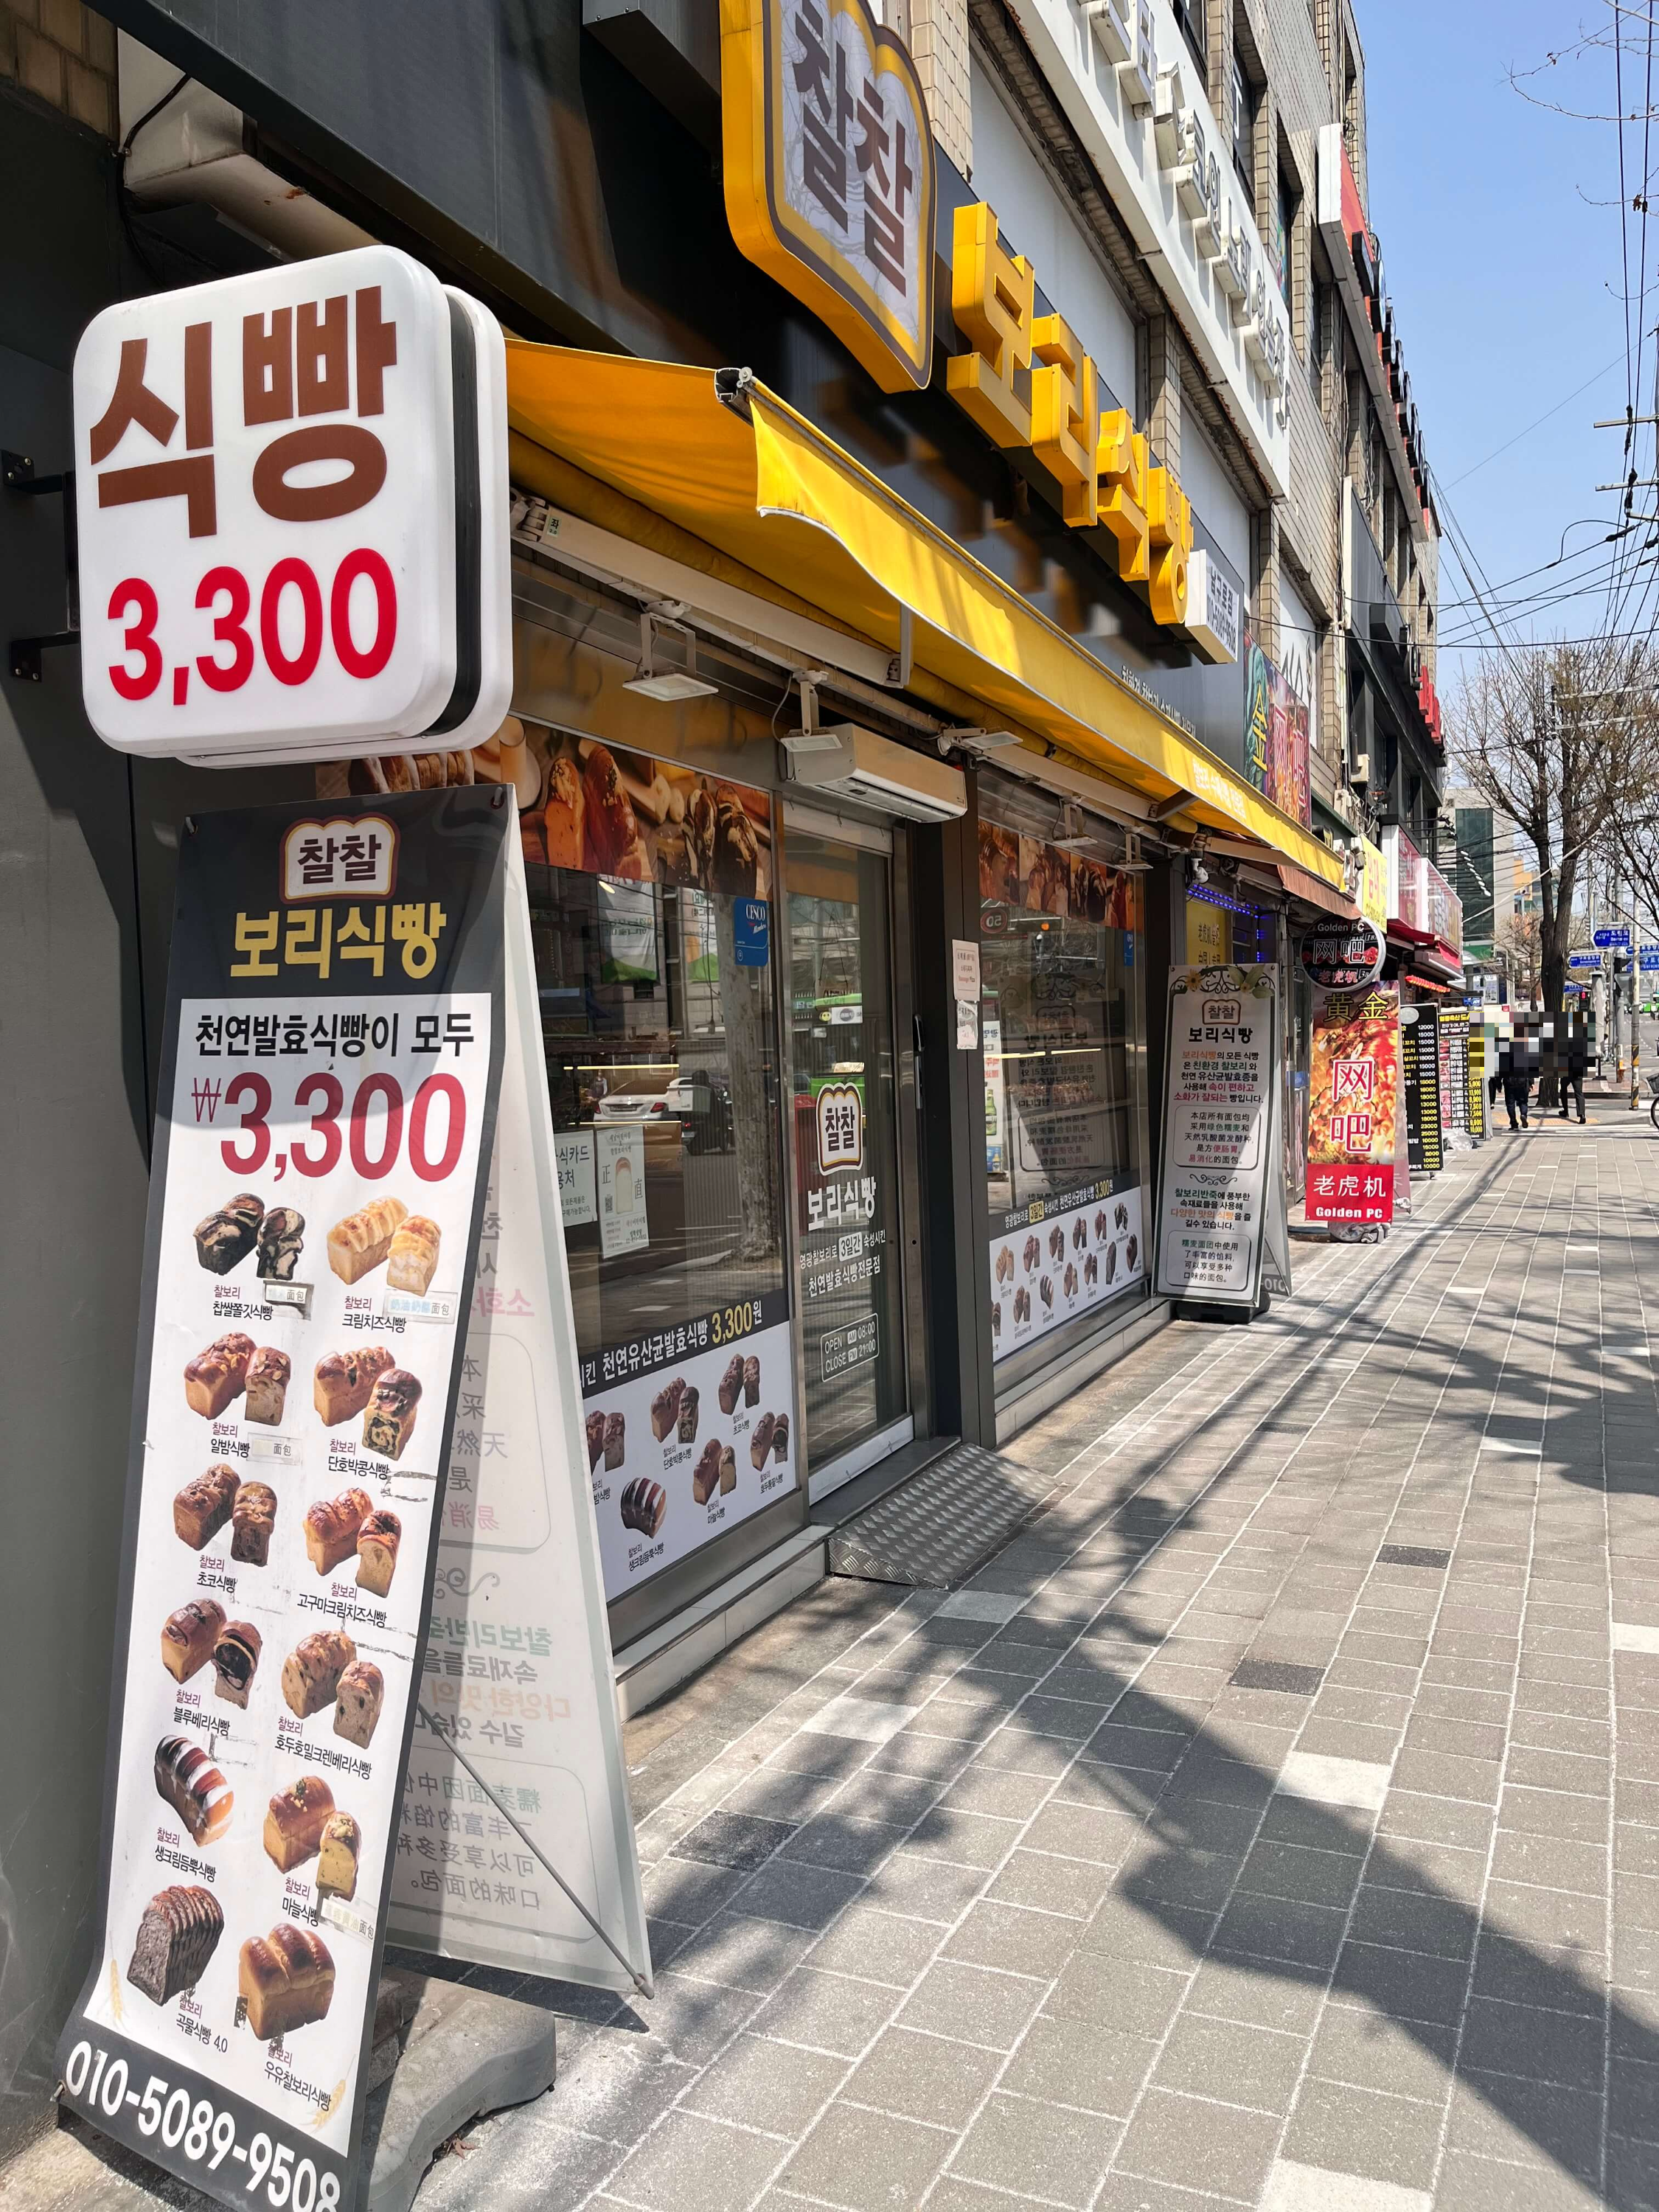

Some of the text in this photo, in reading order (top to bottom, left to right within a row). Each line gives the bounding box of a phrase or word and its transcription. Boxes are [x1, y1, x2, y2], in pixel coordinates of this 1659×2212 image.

[793, 0, 913, 298] 찰찰
[90, 285, 397, 538] 식빵
[947, 201, 1194, 625] 보리식빵
[108, 548, 397, 706] 3,300
[296, 834, 381, 884] 찰찰
[745, 904, 765, 921] CESCO
[1318, 923, 1364, 931] Golden PC
[230, 902, 447, 979] 보리식빵
[1312, 939, 1366, 964] 网吧
[1208, 1005, 1235, 1020] 찰찰
[195, 1013, 475, 1057] 천연발효식빵이 모두
[1188, 1027, 1253, 1043] 보리식빵
[1183, 1061, 1191, 1069] 은
[1193, 1061, 1219, 1071] 친환경
[1221, 1062, 1247, 1071] 찰보리
[1226, 1051, 1242, 1060] 모든
[1243, 1051, 1259, 1060] 식빵
[1180, 1072, 1196, 1081] 천연
[1183, 1082, 1255, 1093] 사용해 속이 편하고
[1173, 1093, 1264, 1104] 소화가 잘되는 빵입니다.
[1329, 1057, 1375, 1155] 网吧
[825, 1105, 855, 1150] 찰찰
[1191, 1112, 1250, 1122] 本店所有面包均
[556, 1145, 590, 1166] 식카드
[1227, 1192, 1251, 1201] 풍부한
[1313, 1175, 1386, 1198] 老虎机
[807, 1176, 877, 1231] 보리식빵
[1171, 1208, 1196, 1218] 다양한
[1198, 1209, 1215, 1219] 맛의
[1220, 1202, 1243, 1211] 사용해
[1315, 1207, 1383, 1219] Golden PC
[1185, 1219, 1235, 1231] 길수 있습니다.
[799, 1228, 886, 1270] 영광찰보리로 3일간 숙성시킨
[1184, 1261, 1233, 1272] 可以享受多种
[214, 1284, 240, 1300] 찰보리
[344, 1295, 372, 1311] 찰보리
[212, 1301, 274, 1321] 찹쌀쫄깃식빵
[341, 1313, 407, 1334] 크림치즈식빵
[824, 1335, 843, 1355] OPEN
[858, 1321, 876, 1338] 08:00
[602, 1318, 708, 1382] 천연유산균발효식빵
[825, 1351, 847, 1373] CLOSE
[858, 1338, 877, 1357] 21:00
[212, 1422, 238, 1437] 찰보리
[210, 1438, 251, 1458] 알밤식빵
[329, 1439, 356, 1455] 찰보리
[327, 1455, 391, 1481] 단호박콩식빵
[199, 1555, 224, 1572] 찰보리
[196, 1571, 237, 1594] 초코식빵
[331, 1582, 357, 1601] 찰보리
[296, 1593, 387, 1629] 고구마크림치즈식빵
[175, 1688, 201, 1708] 찰보리
[173, 1706, 231, 1736] 블루베리식빵
[277, 1716, 303, 1736] 찰보리
[274, 1733, 374, 1781] 호두호밀크렌베리식빵
[156, 1826, 181, 1848] 찰보리
[154, 1844, 217, 1883] 생크림듬뿍식빵
[285, 1877, 311, 1900] 찰보리
[282, 1896, 319, 1927] 마늘식빵
[178, 1994, 203, 2019] 찰보리
[175, 2012, 212, 2045] 곡물식빵
[267, 2042, 293, 2068] 찰보리
[264, 2062, 332, 2112] 우유찰보리식빵
[66, 2040, 341, 2212] 010-5089-9508
